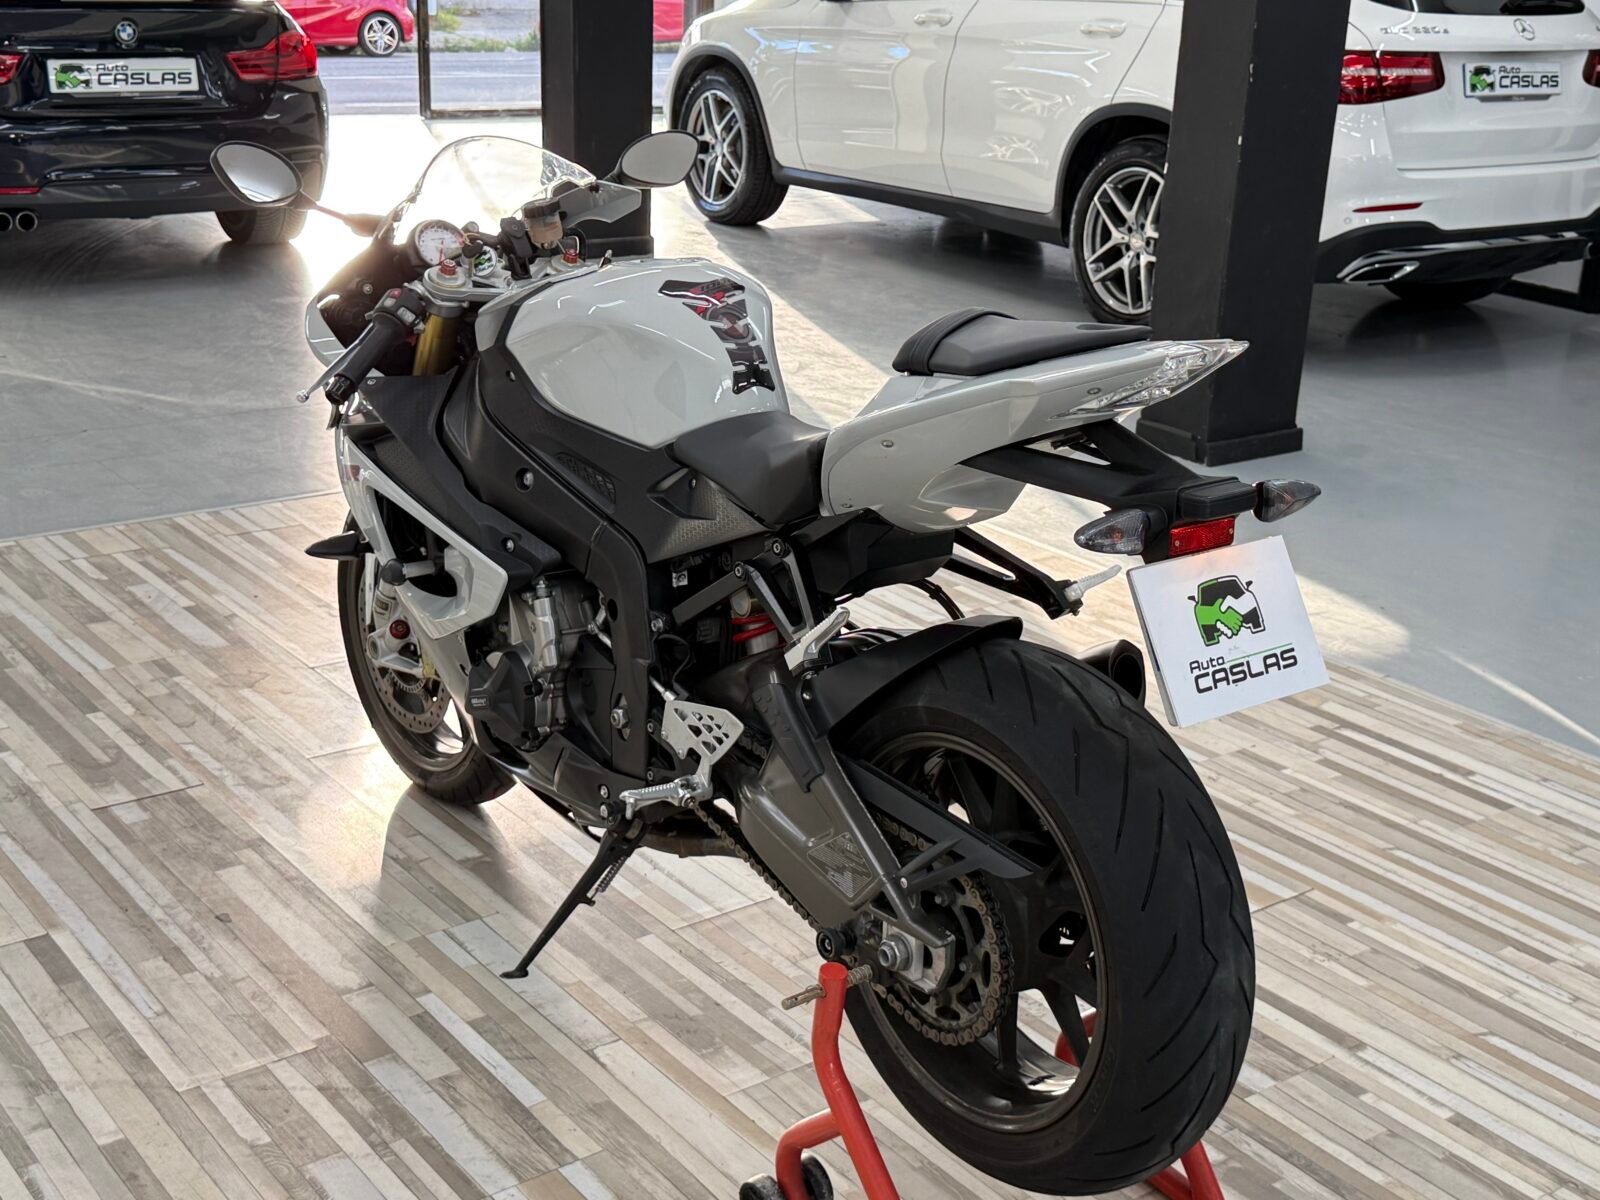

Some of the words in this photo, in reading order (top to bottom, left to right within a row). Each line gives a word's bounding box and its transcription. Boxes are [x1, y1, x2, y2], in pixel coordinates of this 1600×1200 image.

[96, 63, 128, 72] Auto
[1498, 65, 1521, 74] Auto
[98, 72, 192, 85] CASLAS
[1499, 75, 1559, 88] CASLAS
[1189, 656, 1225, 674] Auto
[1194, 647, 1298, 694] CASLAS
